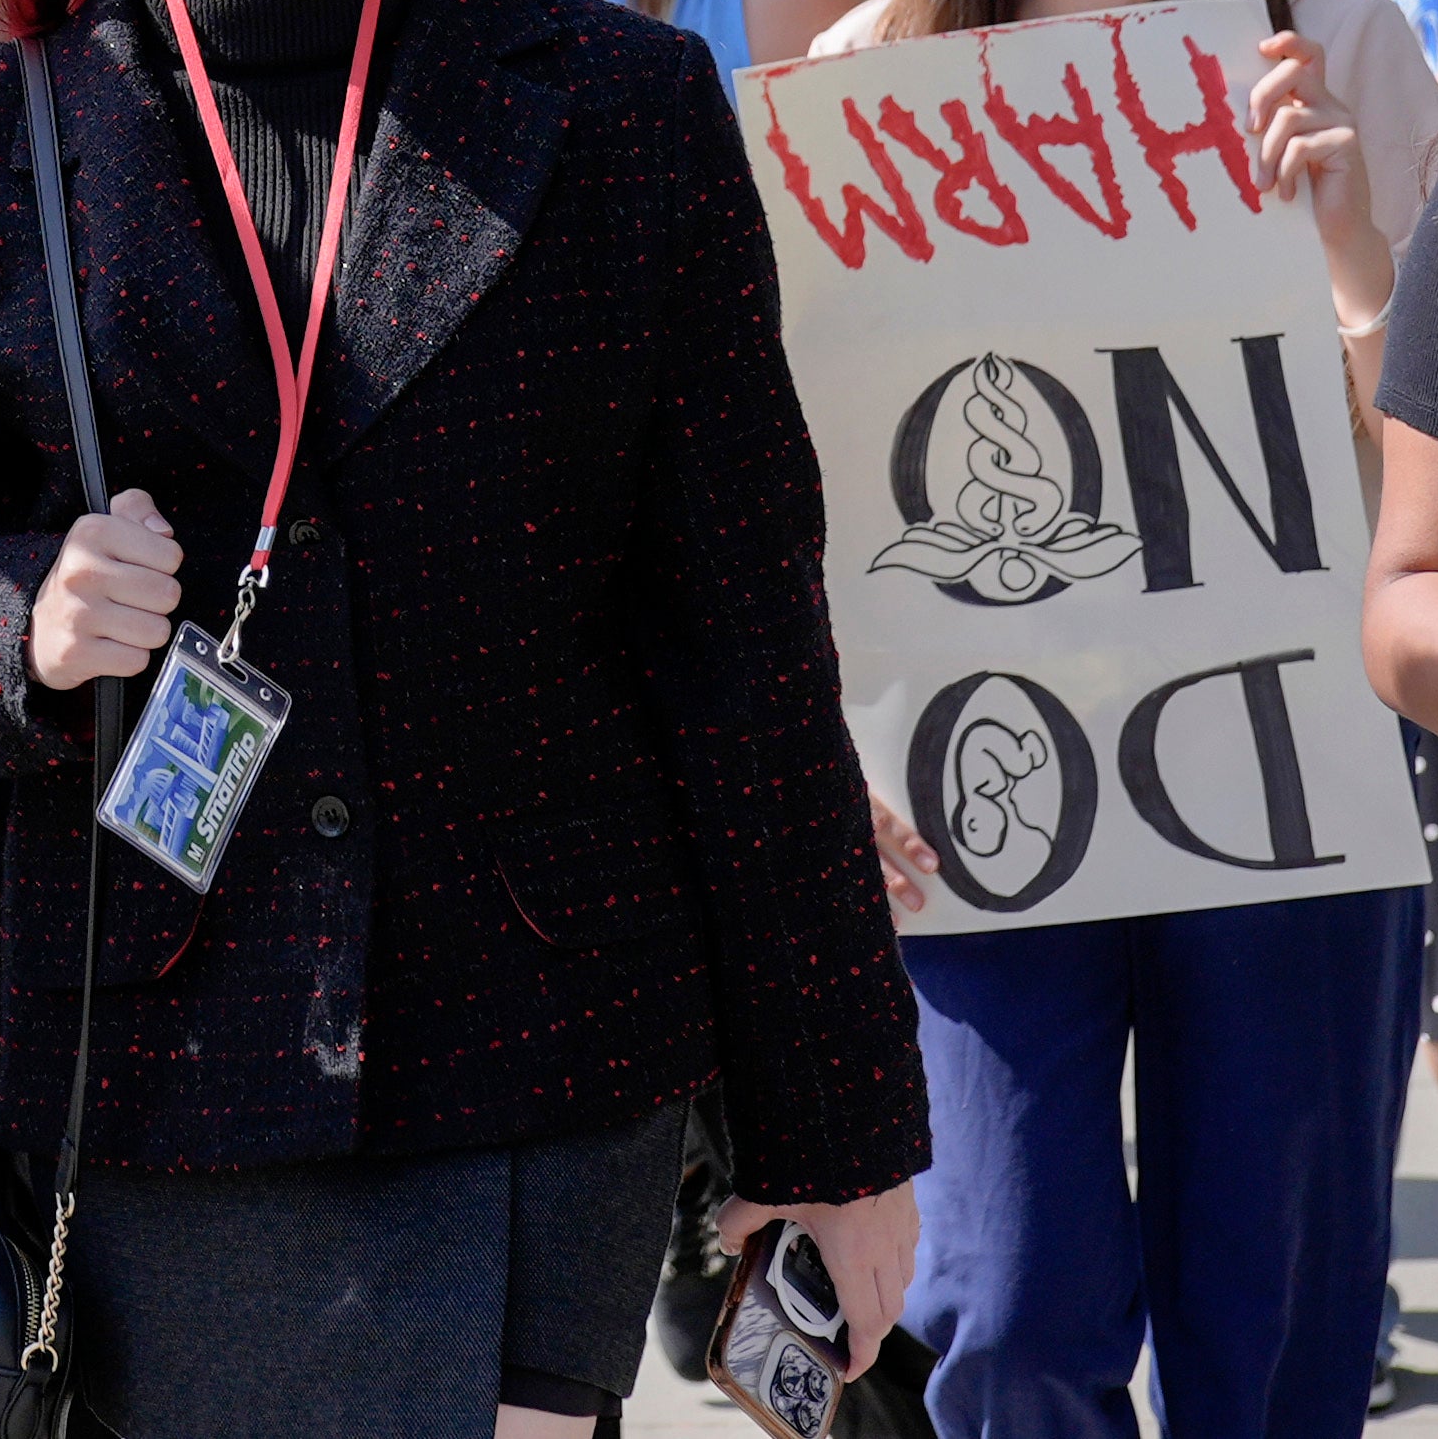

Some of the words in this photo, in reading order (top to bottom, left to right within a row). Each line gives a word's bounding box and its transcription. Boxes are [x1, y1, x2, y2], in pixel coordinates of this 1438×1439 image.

[765, 25, 1265, 269] HARM
[889, 333, 1331, 607] NO
[187, 841, 206, 863] M
[197, 731, 256, 844] SmarTrip
[906, 649, 1346, 913] DO
